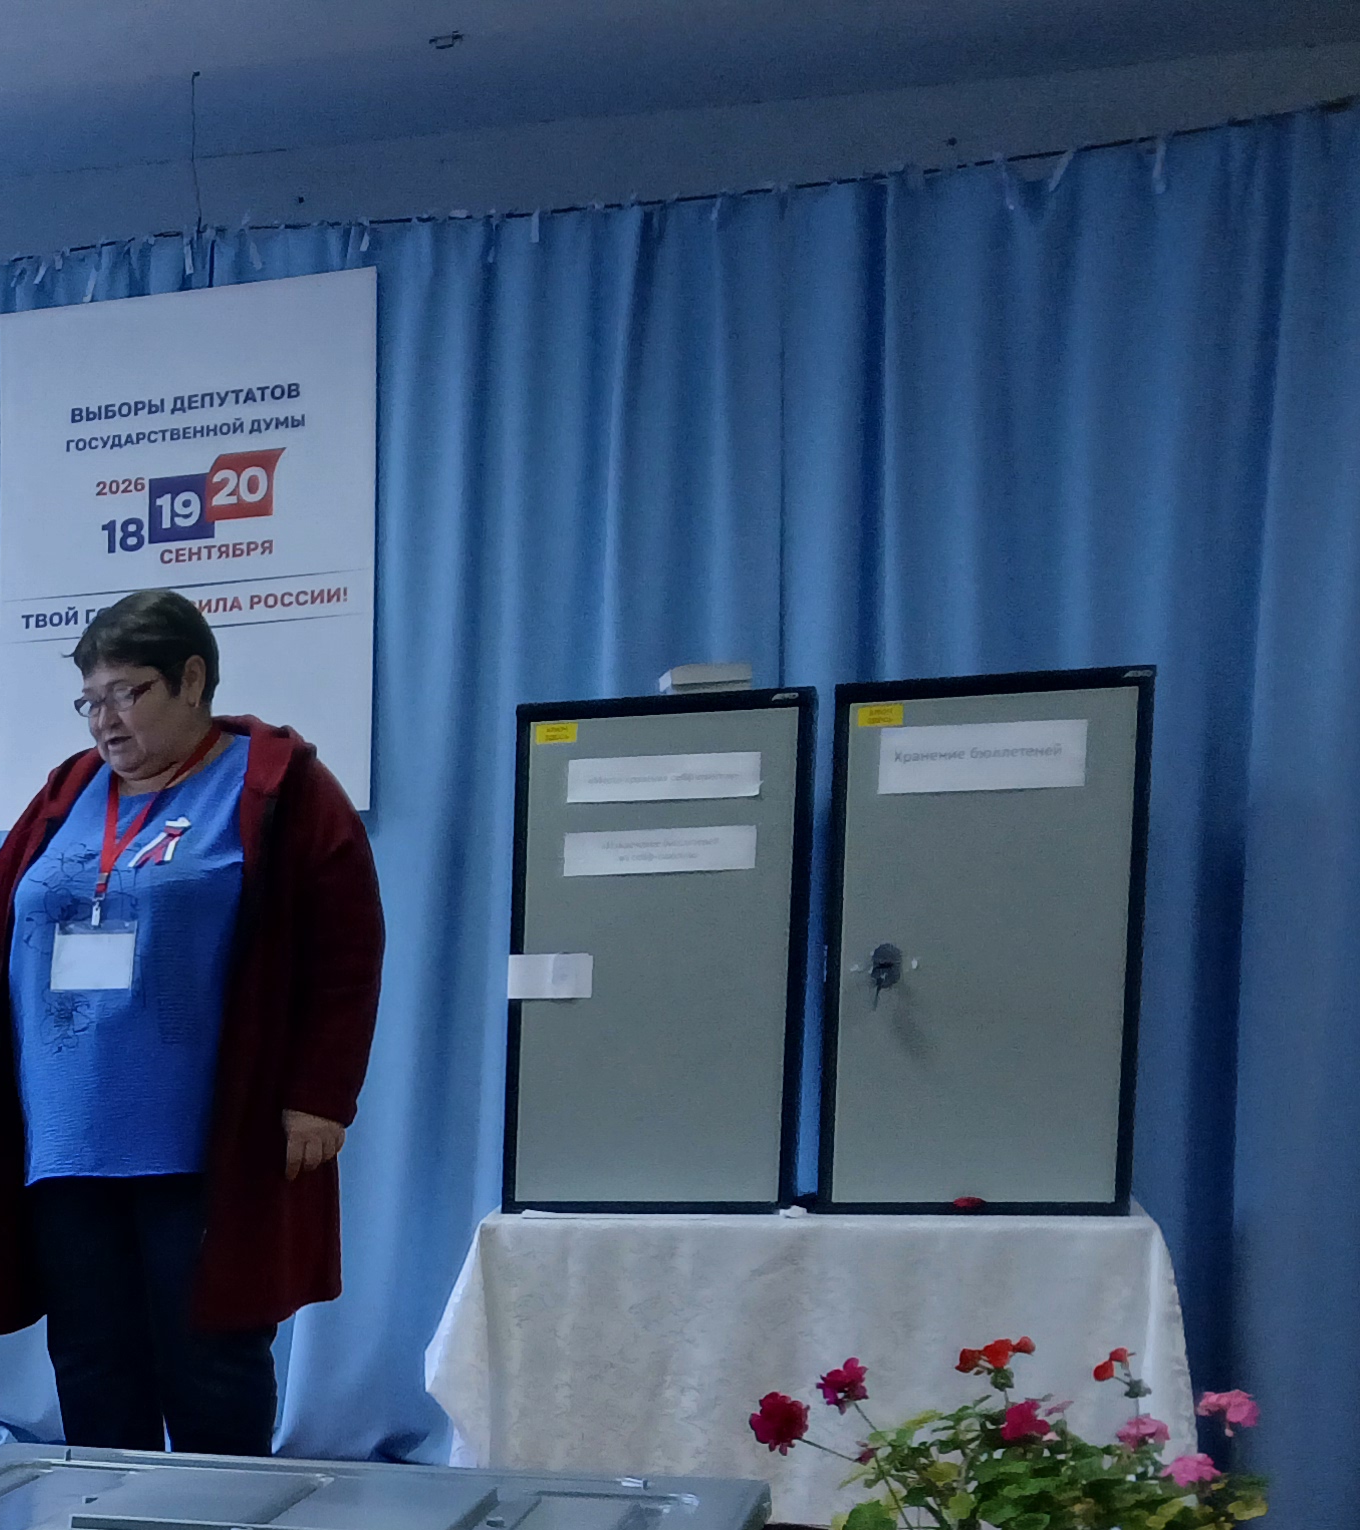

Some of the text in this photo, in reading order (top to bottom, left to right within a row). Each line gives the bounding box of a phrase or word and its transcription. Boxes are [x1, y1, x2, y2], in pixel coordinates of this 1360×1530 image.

[70, 382, 301, 425] ВЫБОРЫ ДЕПУТАТОВ
[65, 413, 306, 453] ГОСУДАРСТВЕННОЙ ДУМЫ
[95, 476, 146, 497] 2026
[101, 465, 269, 555] 18 19 20
[159, 538, 274, 565] СЕНТЯБРЯ
[21, 606, 79, 630] ТВОЙ
[195, 596, 242, 616] ИЛА
[248, 586, 349, 611] РОССИИ!
[894, 748, 965, 763] Хранение
